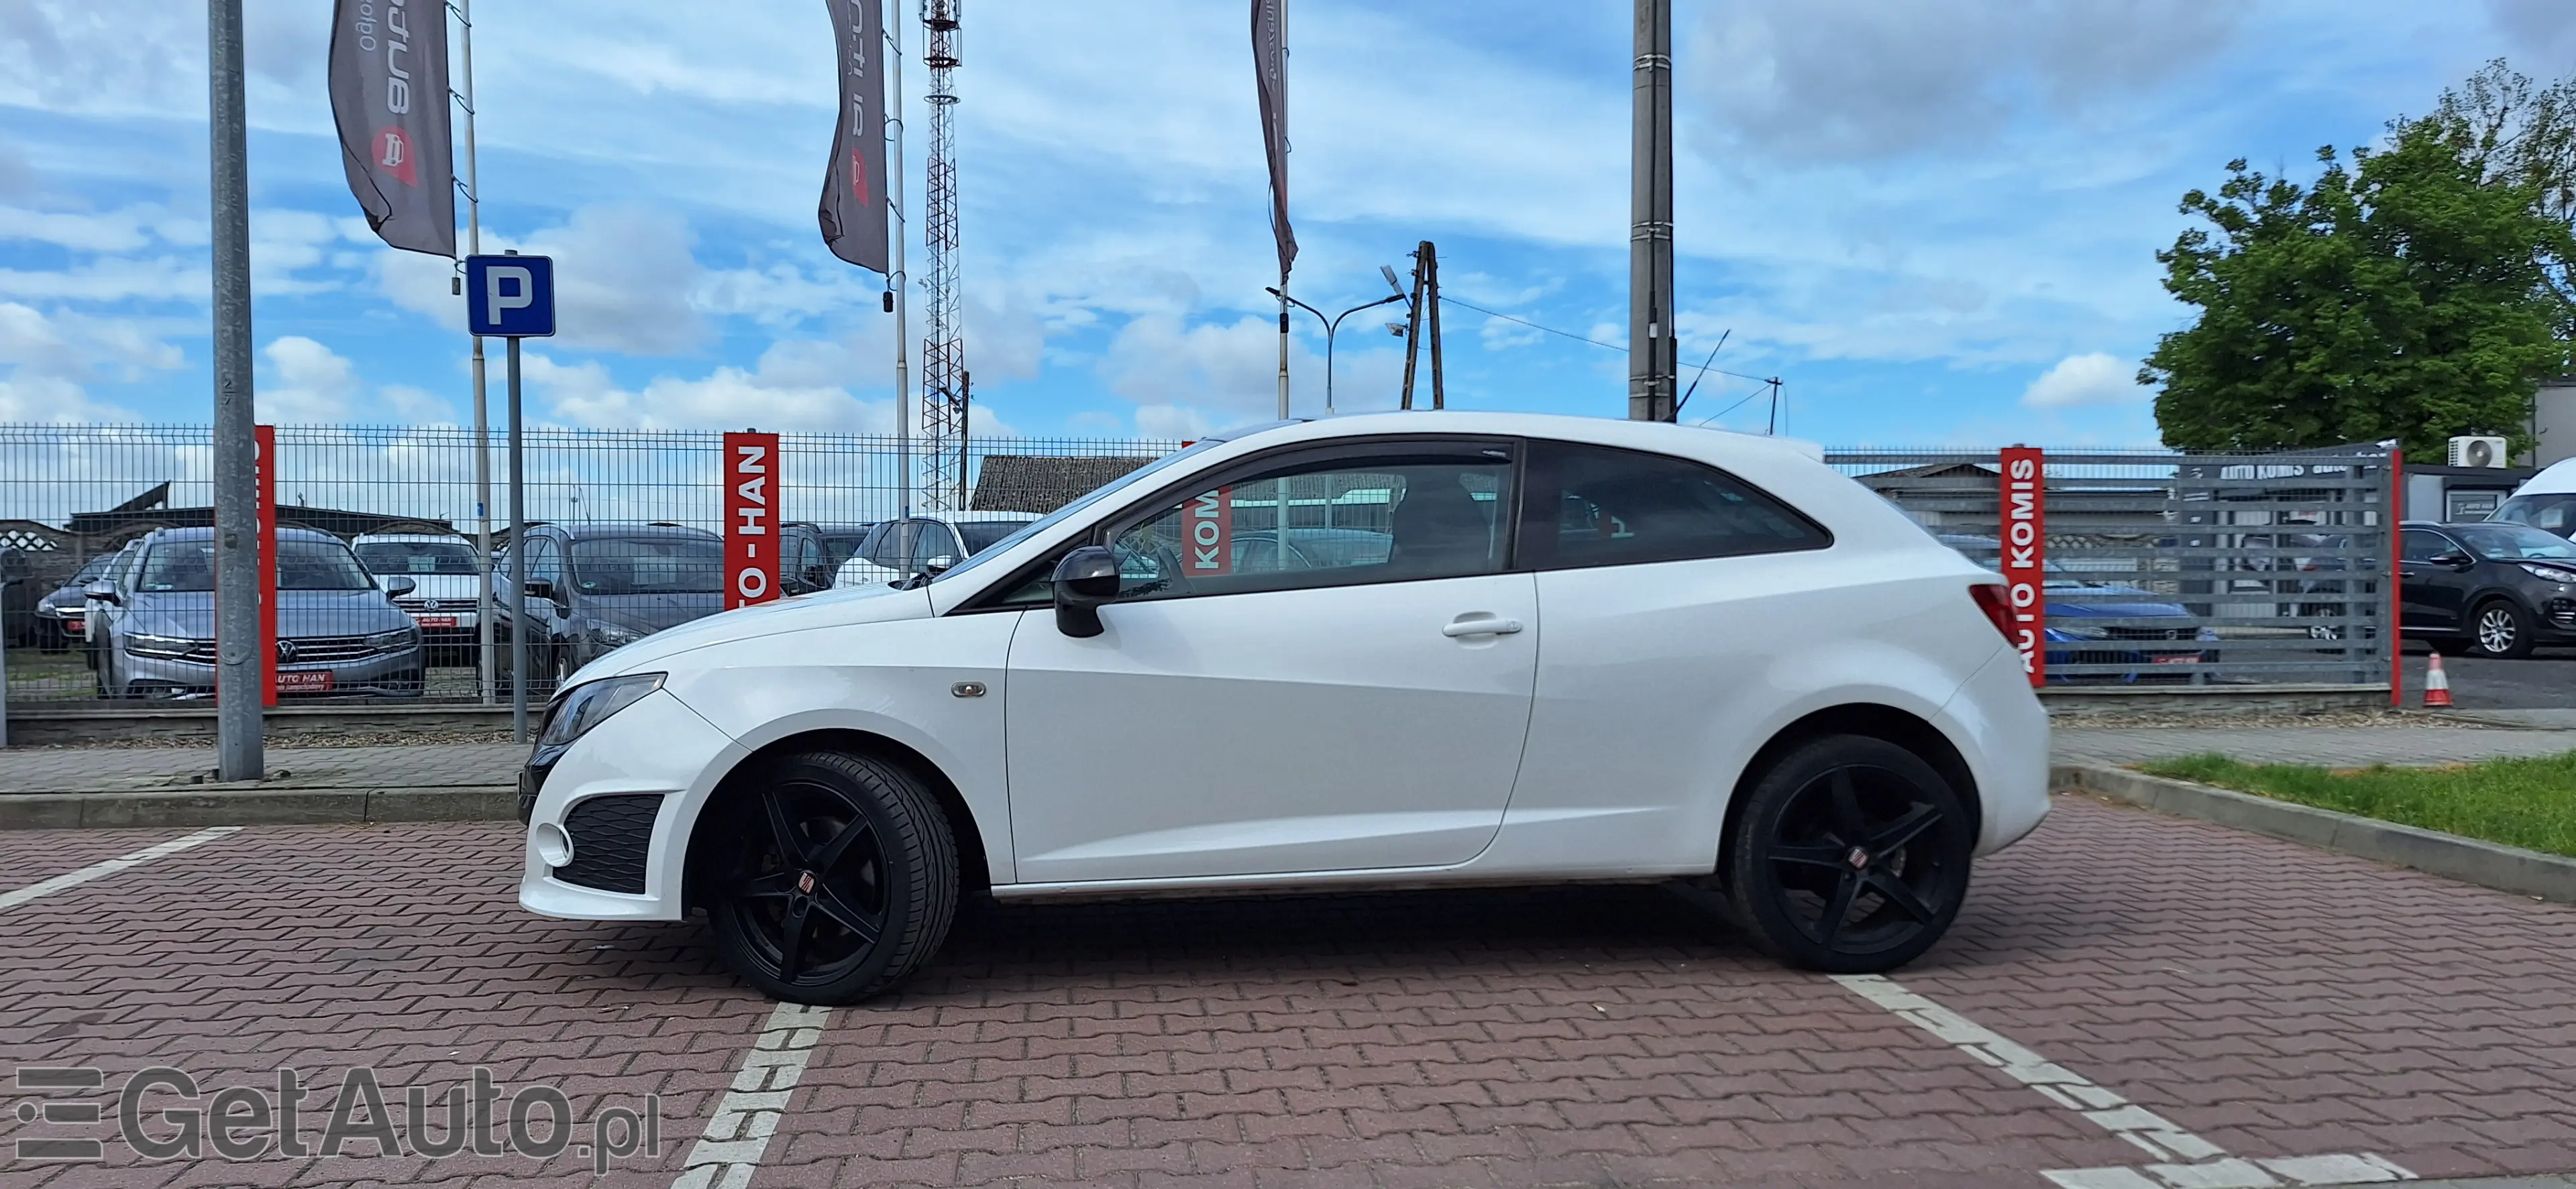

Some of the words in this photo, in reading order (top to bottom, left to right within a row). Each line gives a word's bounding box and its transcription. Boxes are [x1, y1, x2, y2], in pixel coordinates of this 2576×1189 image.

[486, 266, 533, 325] P
[738, 446, 766, 535] HAN
[2010, 459, 2035, 569] KOMIS
